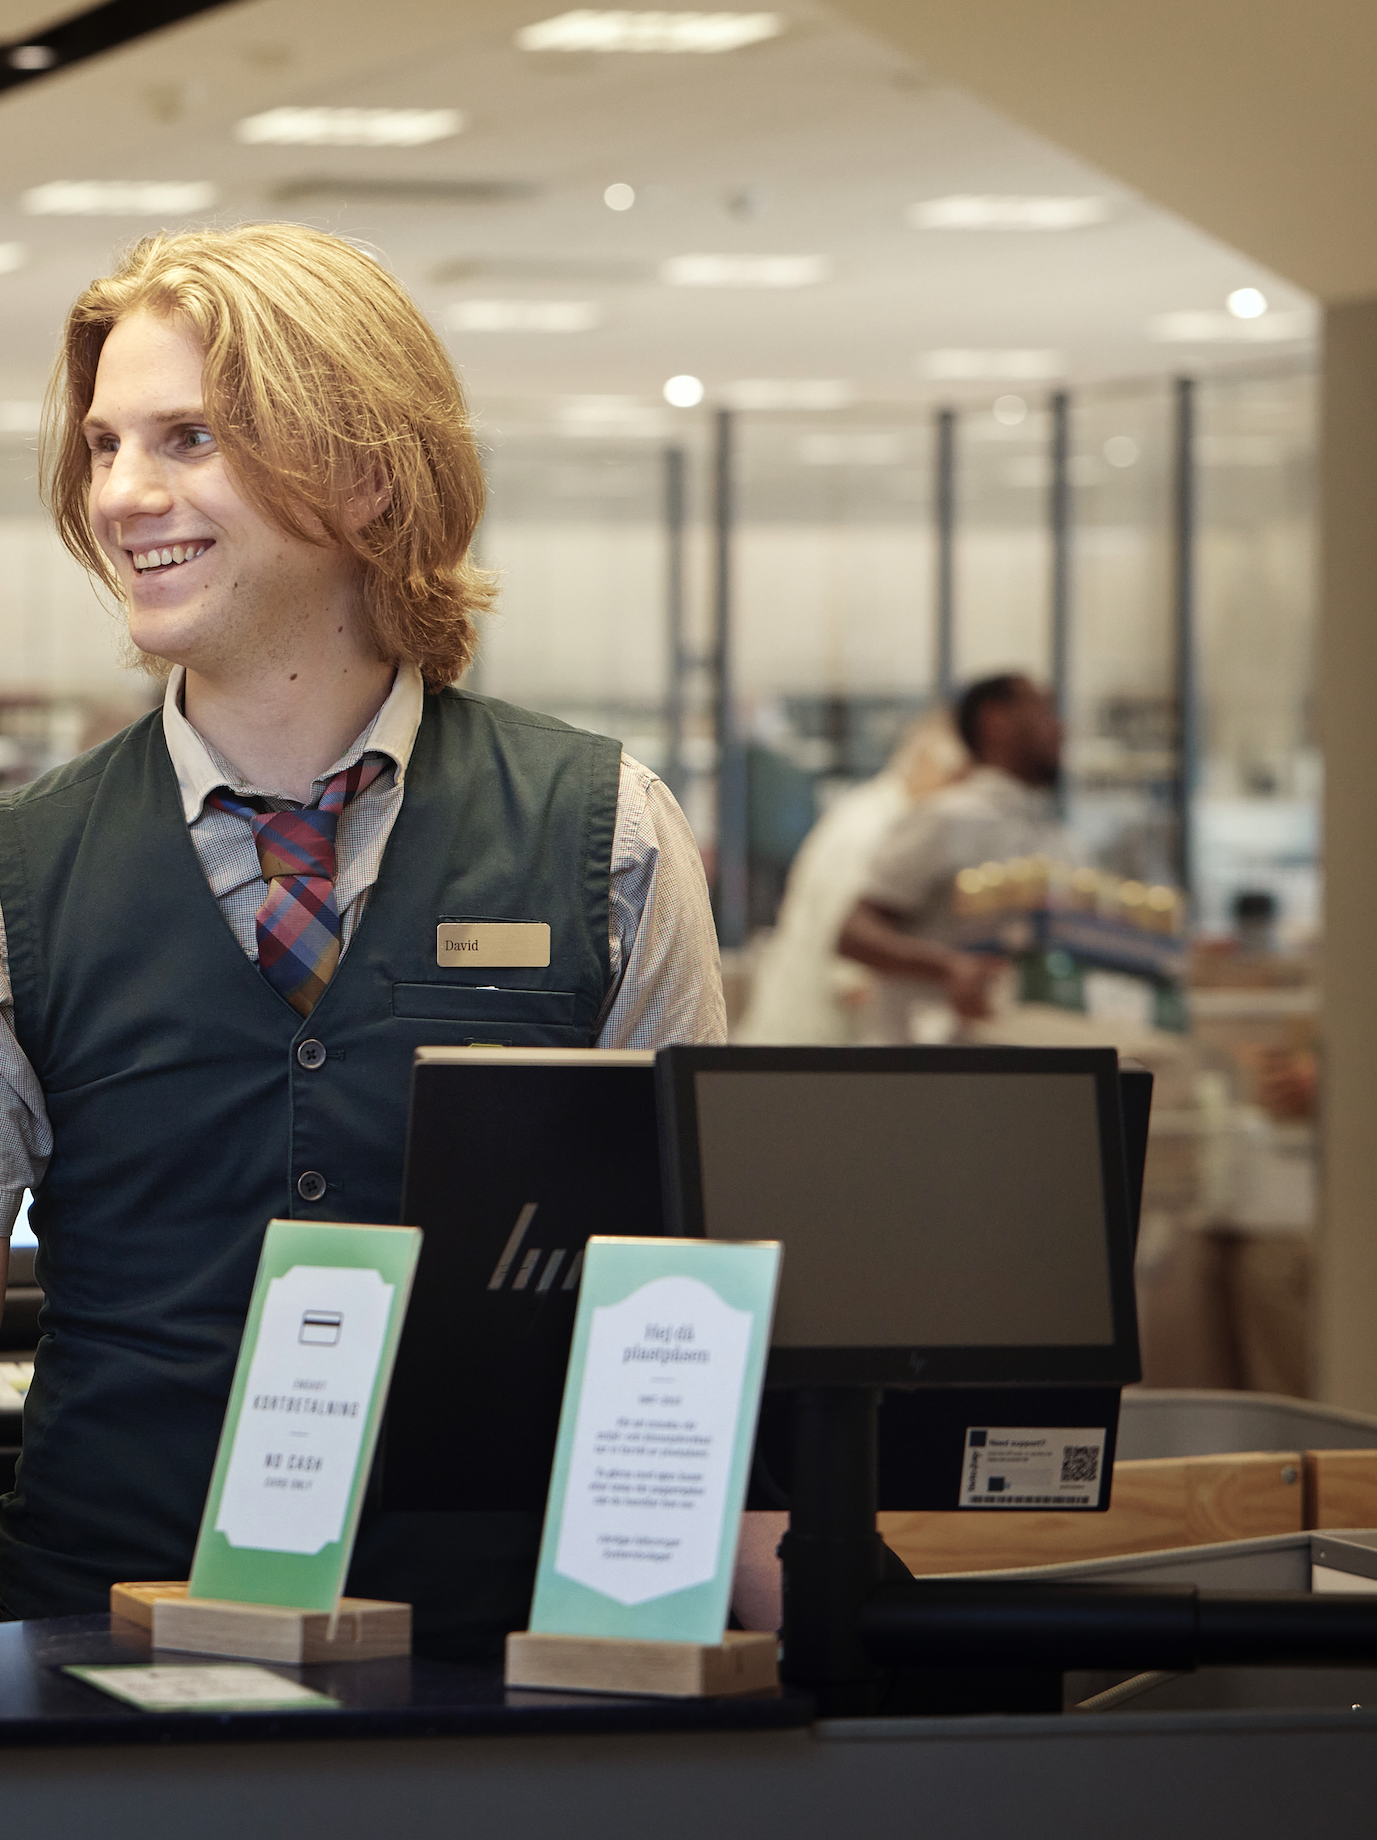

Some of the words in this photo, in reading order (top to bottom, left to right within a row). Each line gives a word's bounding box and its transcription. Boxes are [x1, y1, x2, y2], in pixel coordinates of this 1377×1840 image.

[445, 940, 479, 951] David
[252, 1394, 360, 1419] KORTBETALNING
[264, 1452, 283, 1469] NO
[286, 1453, 324, 1472] CASH
